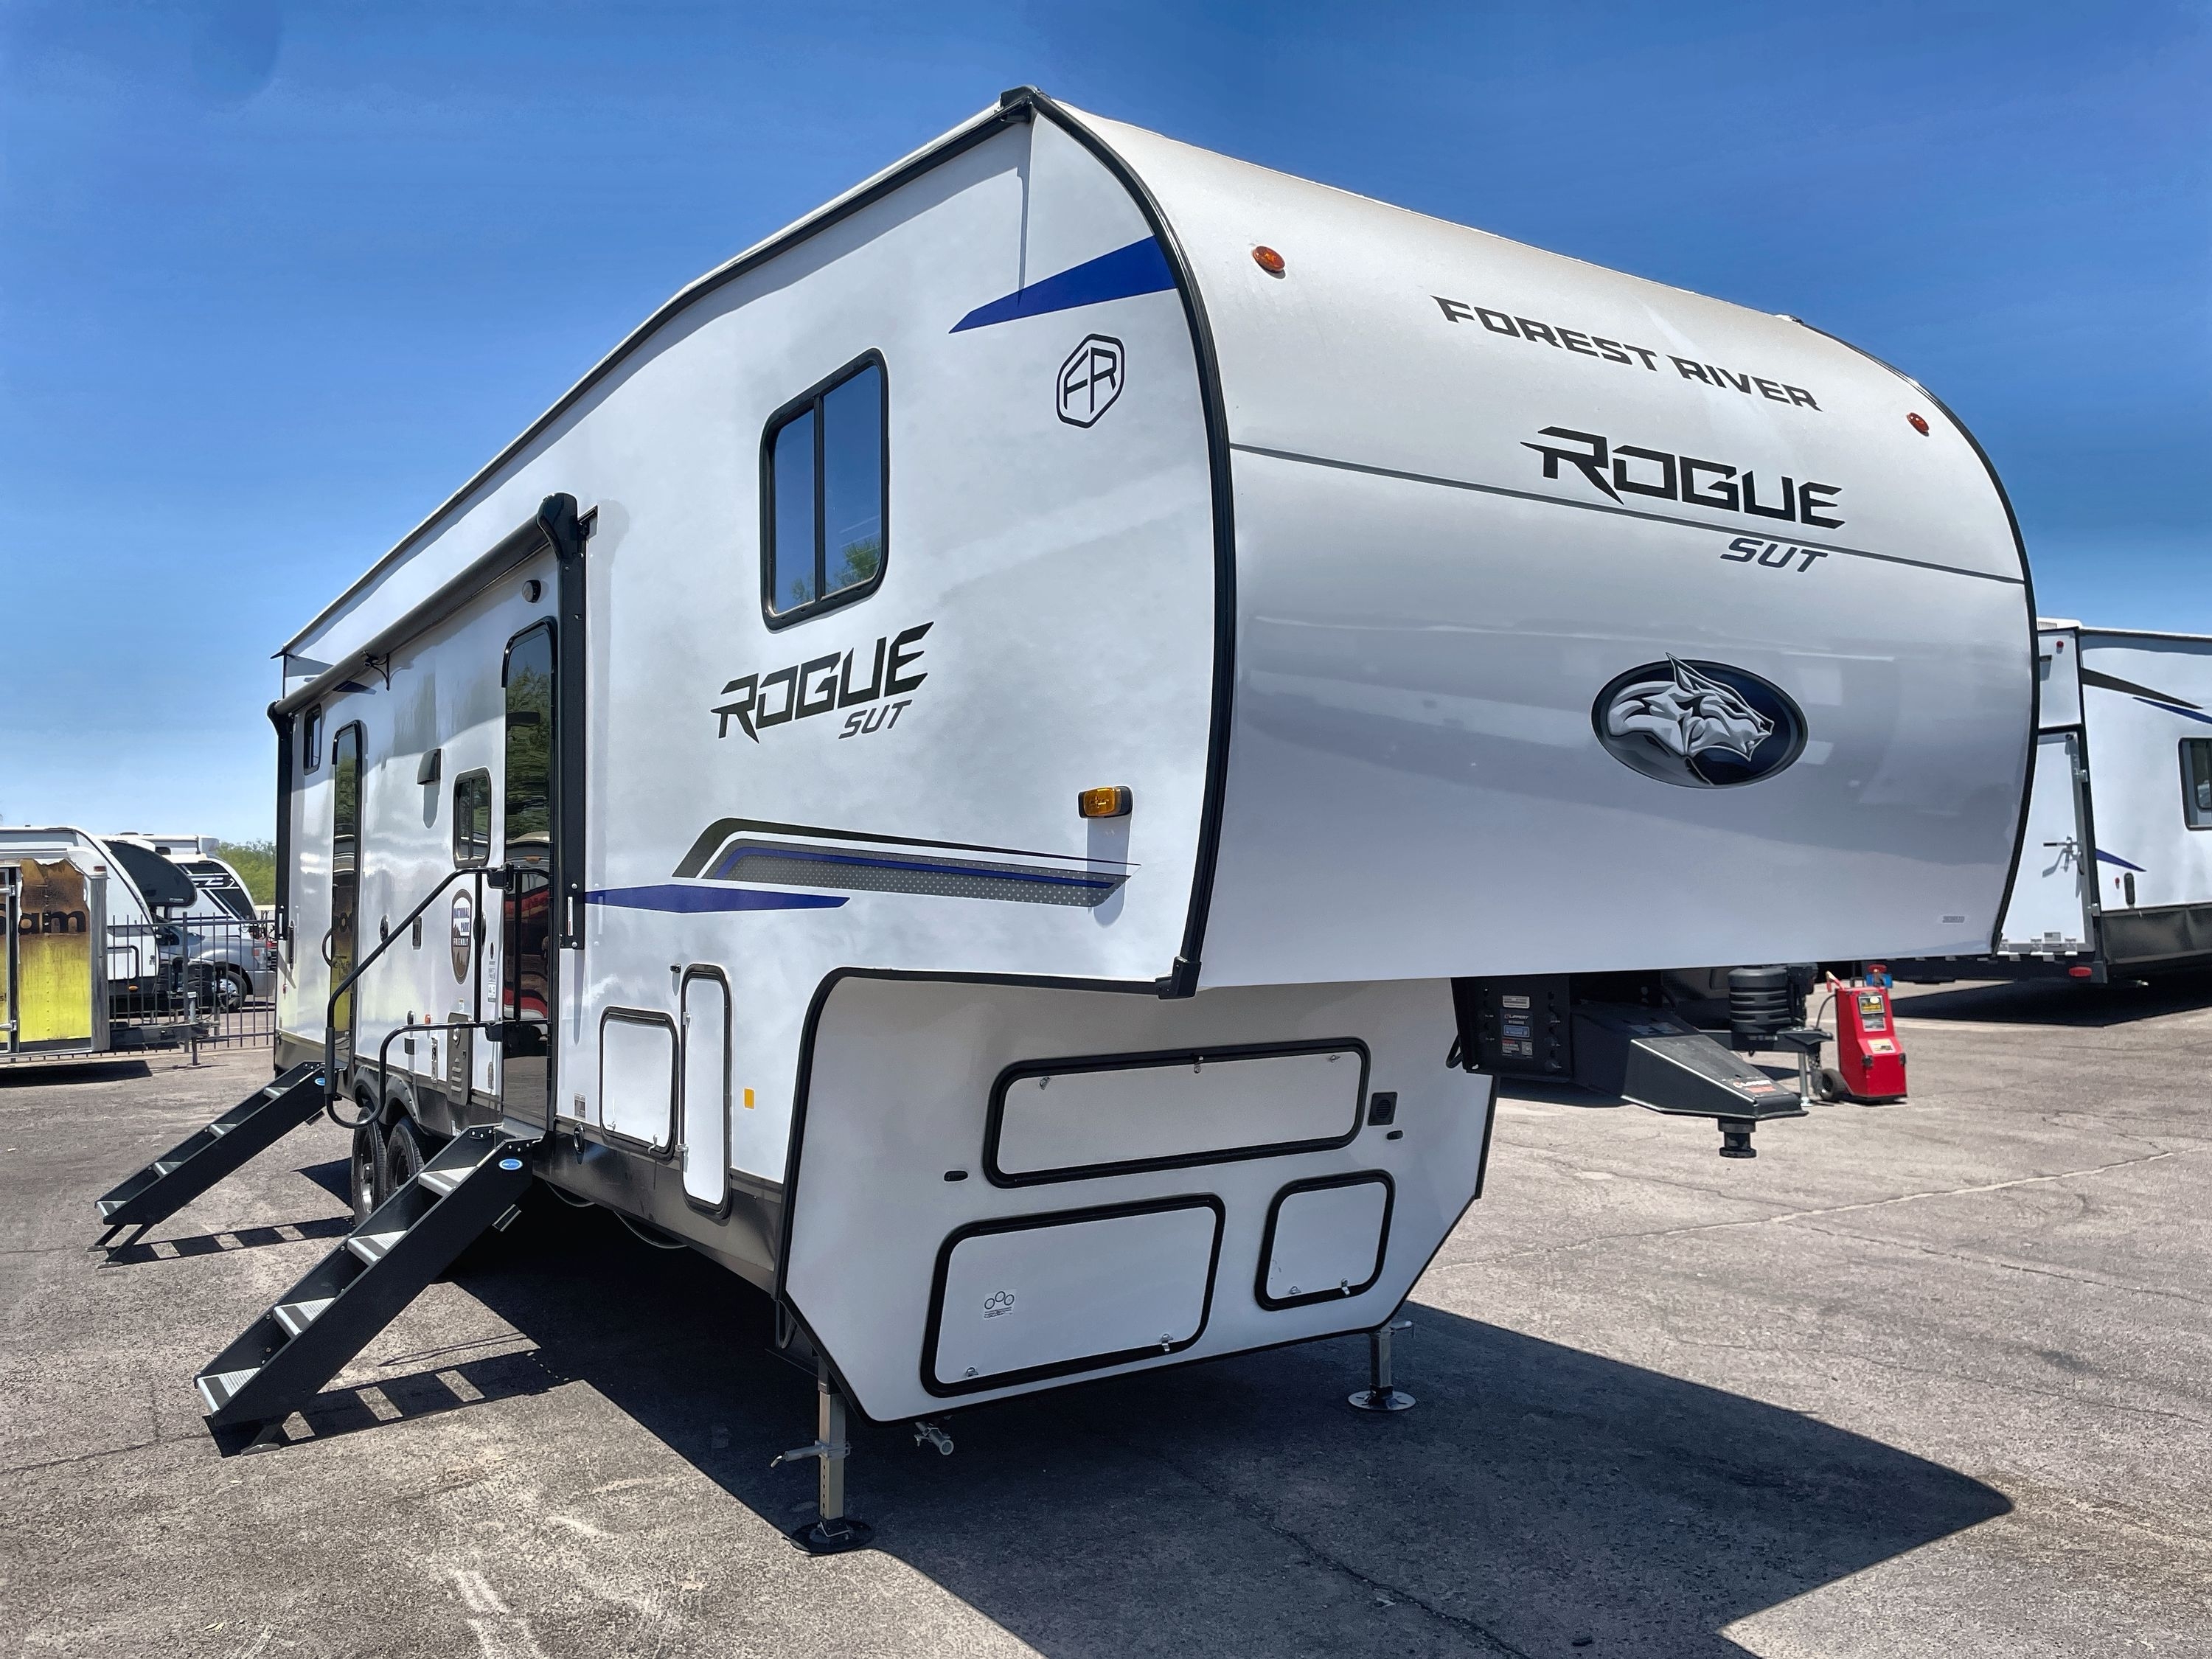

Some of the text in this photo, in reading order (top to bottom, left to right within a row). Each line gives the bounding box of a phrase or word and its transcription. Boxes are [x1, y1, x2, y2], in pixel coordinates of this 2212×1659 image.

[1430, 295, 1823, 411] FOREST RIVER
[1520, 426, 1846, 529] ROGUE
[1720, 537, 1829, 573] SUT
[710, 621, 934, 744] ROGUE
[838, 699, 913, 740] SUT
